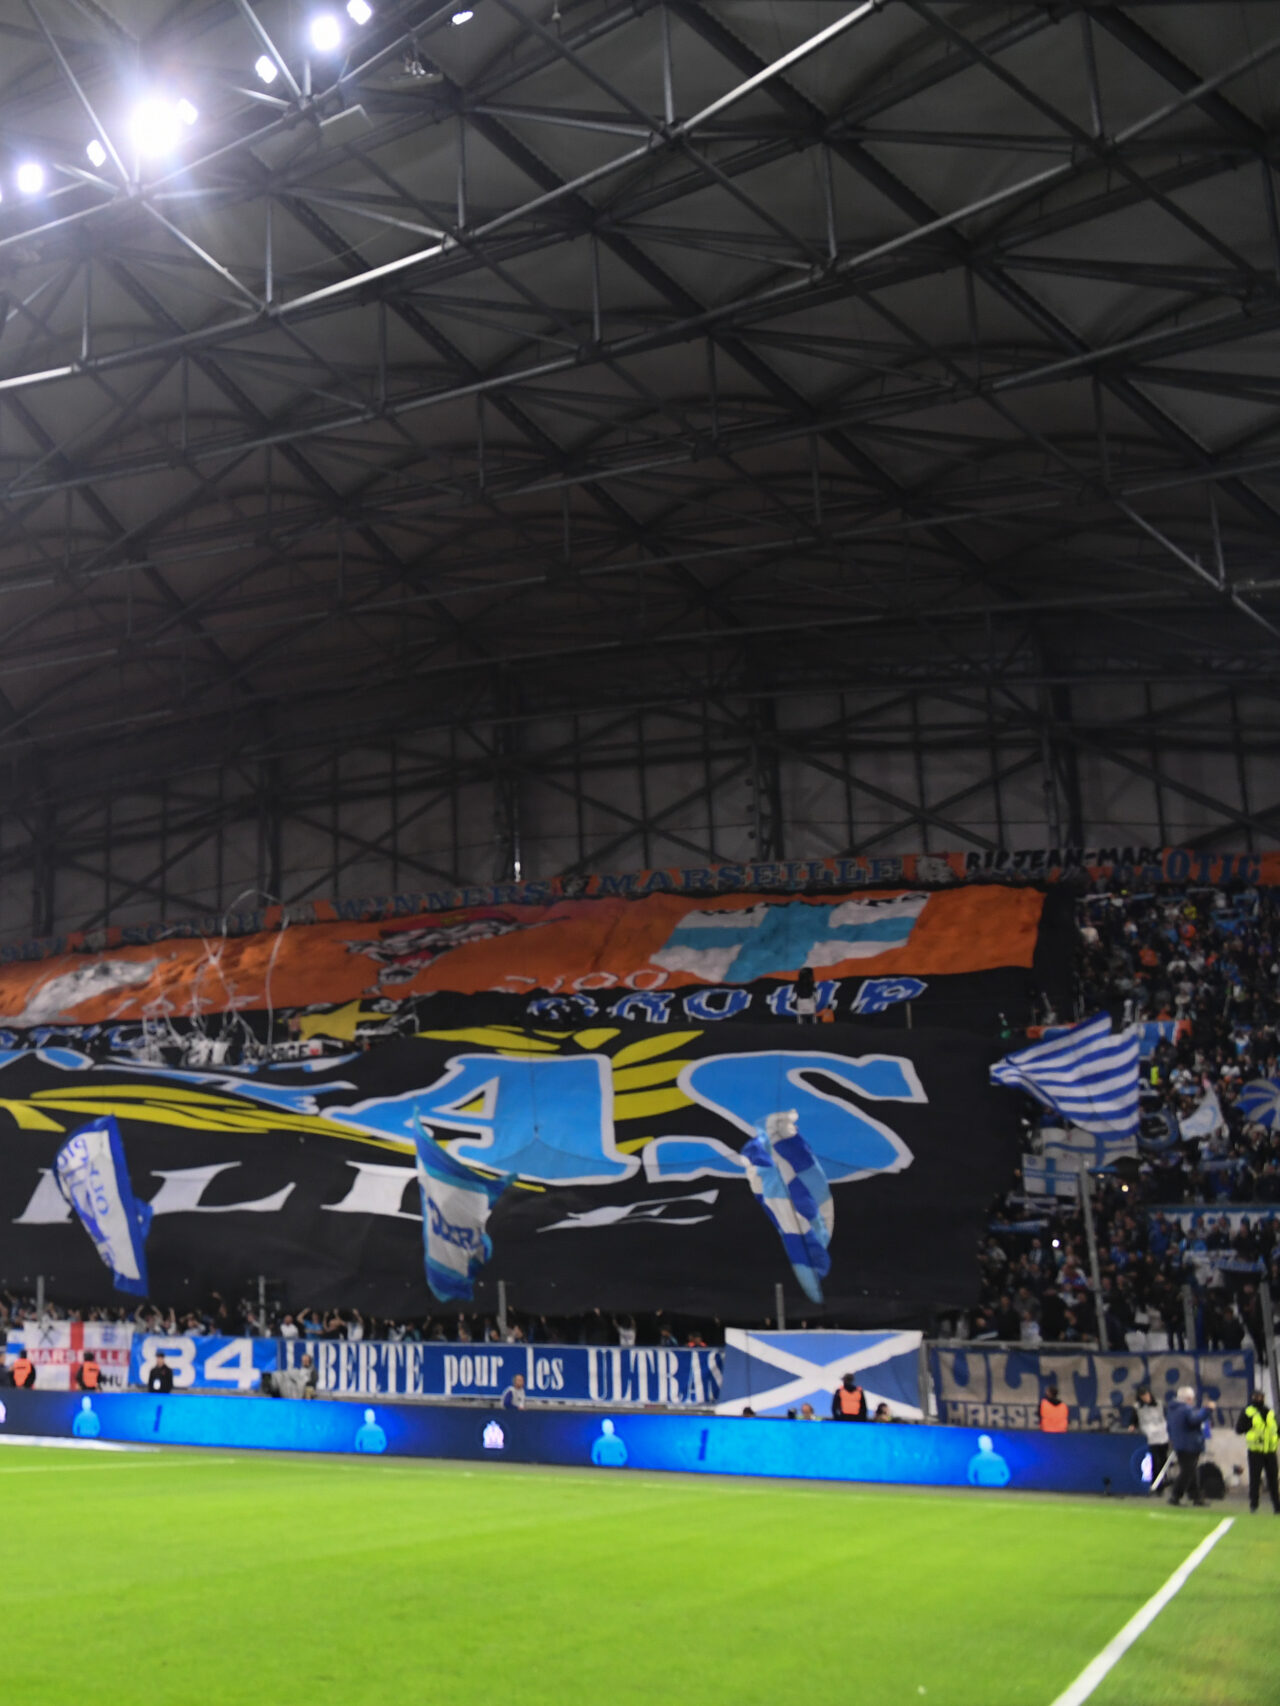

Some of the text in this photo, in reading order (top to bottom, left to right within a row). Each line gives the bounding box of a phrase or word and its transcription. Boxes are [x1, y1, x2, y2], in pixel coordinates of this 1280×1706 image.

[332, 880, 552, 920] WINNERS
[598, 856, 902, 893] MARSEILLE
[28, 1348, 128, 1367] MARSELLE
[138, 1336, 261, 1389] 84
[444, 1354, 504, 1395] pour
[527, 1347, 565, 1392] les
[587, 1348, 724, 1405] ULTRAS
[938, 1351, 1248, 1407] ULTRAS
